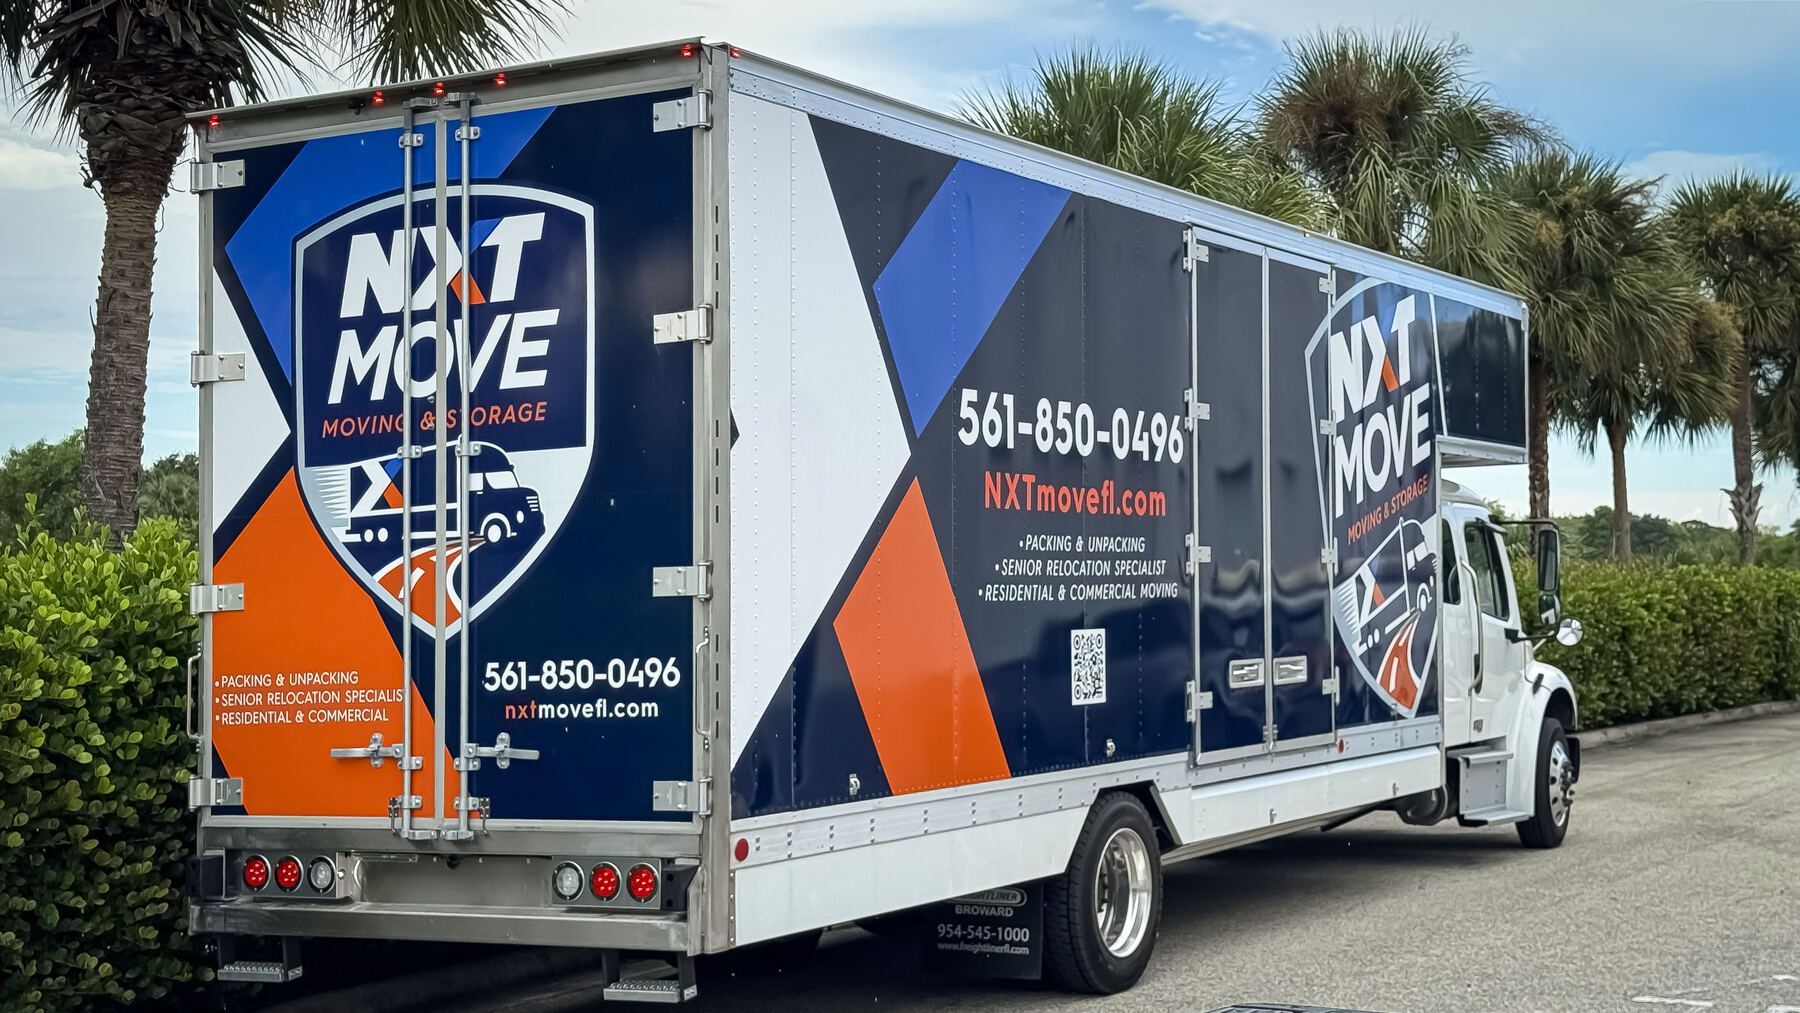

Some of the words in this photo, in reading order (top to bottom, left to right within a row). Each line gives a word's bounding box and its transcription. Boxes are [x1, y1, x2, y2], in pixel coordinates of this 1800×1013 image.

[338, 211, 546, 319] NXT
[327, 308, 561, 405] MOVE
[1330, 294, 1416, 424] NXT
[322, 414, 404, 438] MOVING
[420, 412, 437, 430] &
[446, 402, 547, 428] SORAGE
[958, 388, 1184, 464] 561-850-0496
[1335, 382, 1431, 519] MOVE
[984, 471, 1166, 516] NXTmovefl.com
[1347, 507, 1382, 545] MOVING
[1384, 504, 1390, 520] &
[1391, 473, 1429, 513] STORAGE
[1026, 534, 1072, 551] PACKING
[1076, 538, 1084, 551] &
[1088, 536, 1146, 553] UNPACKING
[1001, 559, 1042, 576] SENIOR
[1046, 559, 1110, 577] RELOCATION
[1114, 559, 1166, 576] SPECIALIST
[985, 584, 1053, 601] RESIDENTIAL
[1058, 586, 1066, 600] &
[1070, 583, 1136, 600] COMMERCIAL
[1140, 583, 1178, 599] MOVING
[221, 674, 272, 688] PACKING
[276, 674, 285, 687] &
[289, 671, 359, 685] UNPACKING
[484, 657, 681, 691] 561-850-0496
[221, 692, 263, 707] SENIOR
[267, 690, 340, 705] RELOCATION
[345, 689, 405, 703] SPECIALIS
[505, 698, 659, 719] nxtmovefl.com
[221, 711, 292, 725] RESIDENTIAL
[295, 710, 304, 723] &
[308, 708, 389, 723] COMMERCIAL
[955, 904, 1013, 917] BROWARD
[937, 923, 1030, 942] 954-545-1000
[937, 941, 1030, 954] www.freightlinerfl.com
